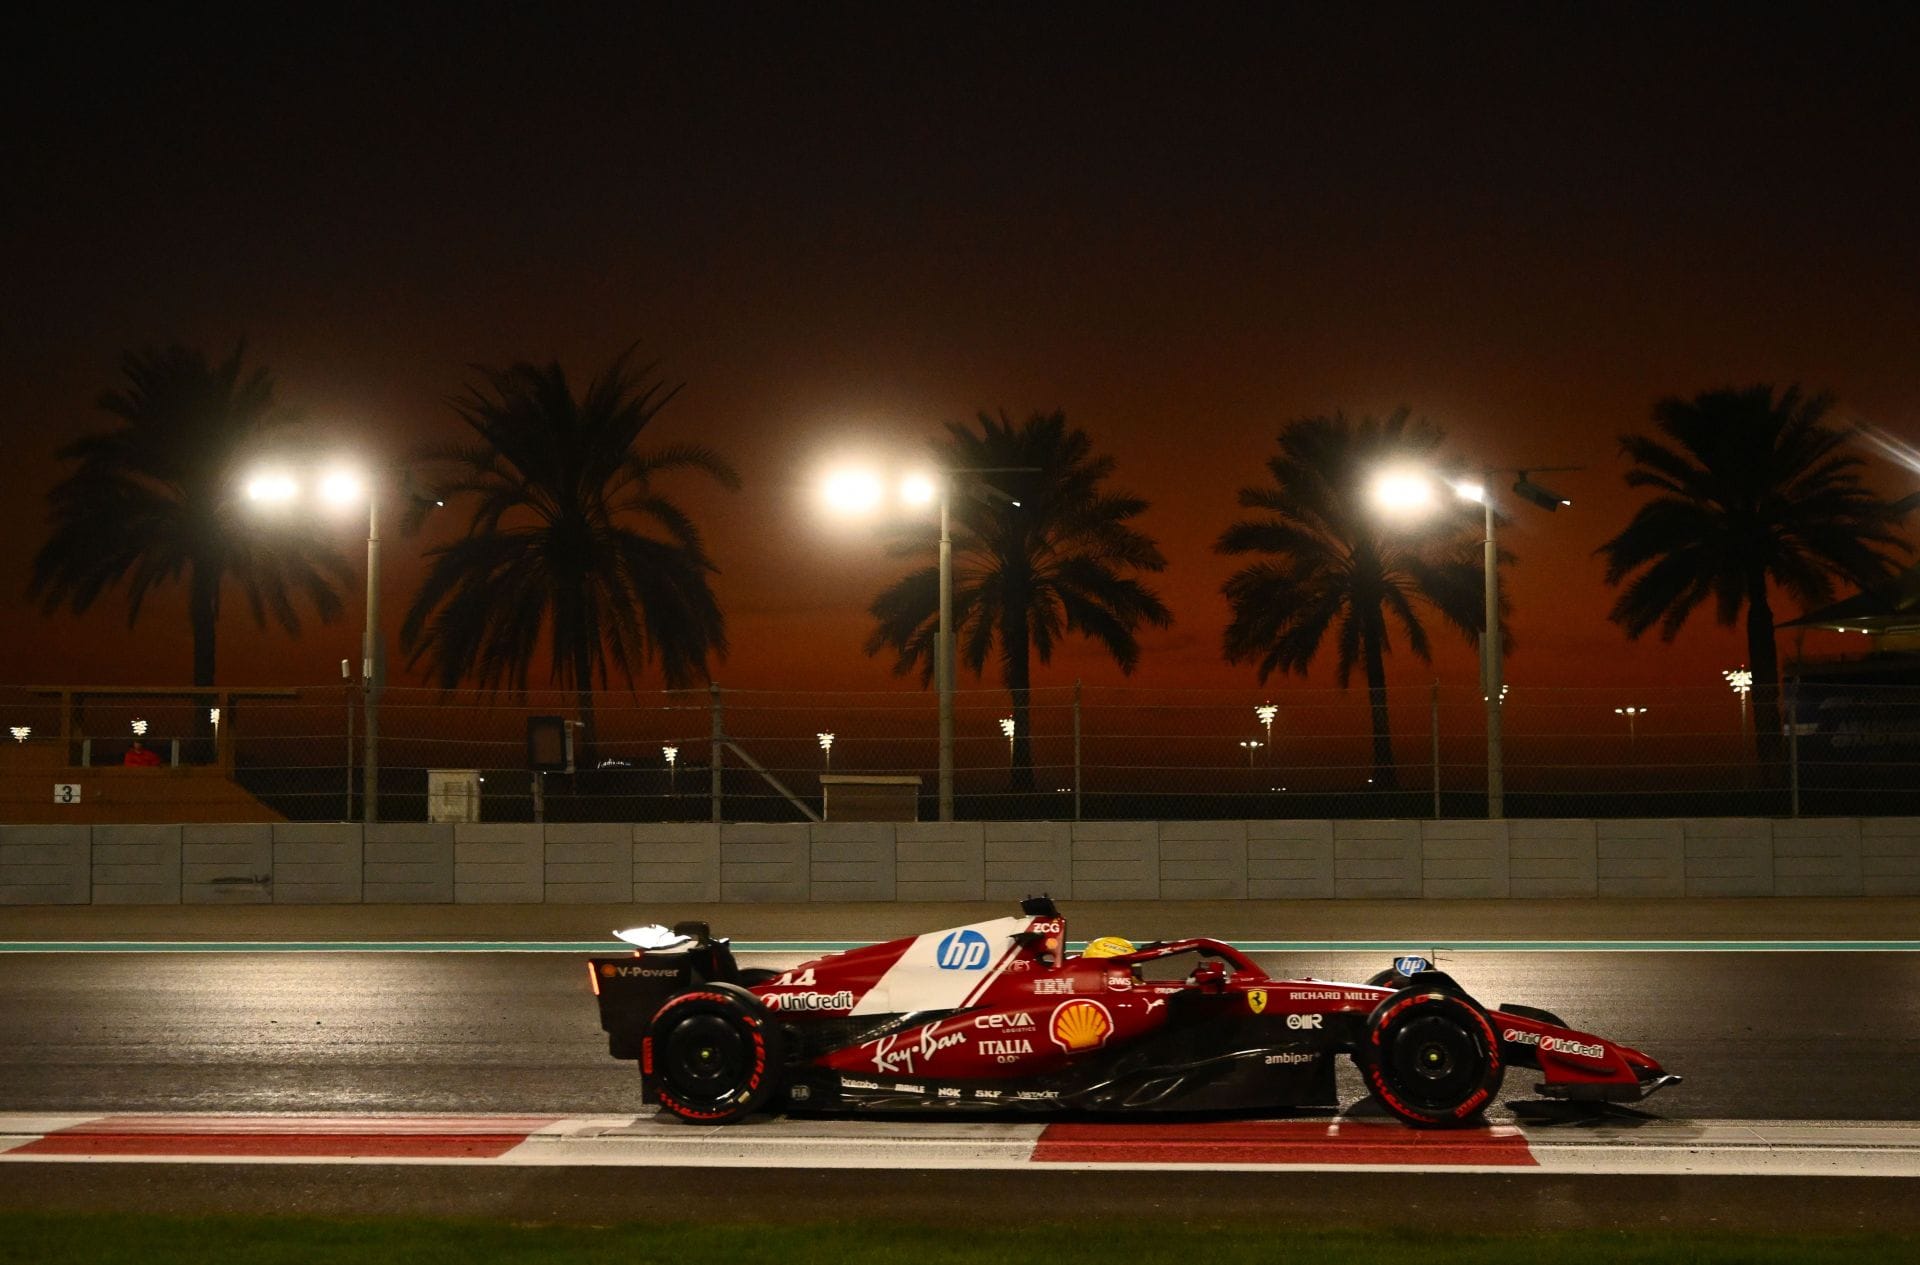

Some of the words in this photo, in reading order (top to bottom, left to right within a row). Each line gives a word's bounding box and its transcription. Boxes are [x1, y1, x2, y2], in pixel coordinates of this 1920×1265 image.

[62, 785, 72, 803] 3
[1033, 922, 1060, 933] ZCG
[939, 930, 987, 969] hp
[617, 966, 679, 977] V-Power
[1399, 957, 1423, 976] hp
[1034, 978, 1075, 994] IBM
[1108, 977, 1132, 986] aws
[780, 992, 852, 1011] UniCredit
[1290, 992, 1341, 1000] RICHARD
[1344, 992, 1379, 1001] MILLE
[978, 1039, 1033, 1055] ITALIA
[1554, 1038, 1604, 1058] UniCredit
[1264, 1053, 1313, 1065] ambipar
[791, 1088, 809, 1098] FIA
[938, 1088, 961, 1097] NGK
